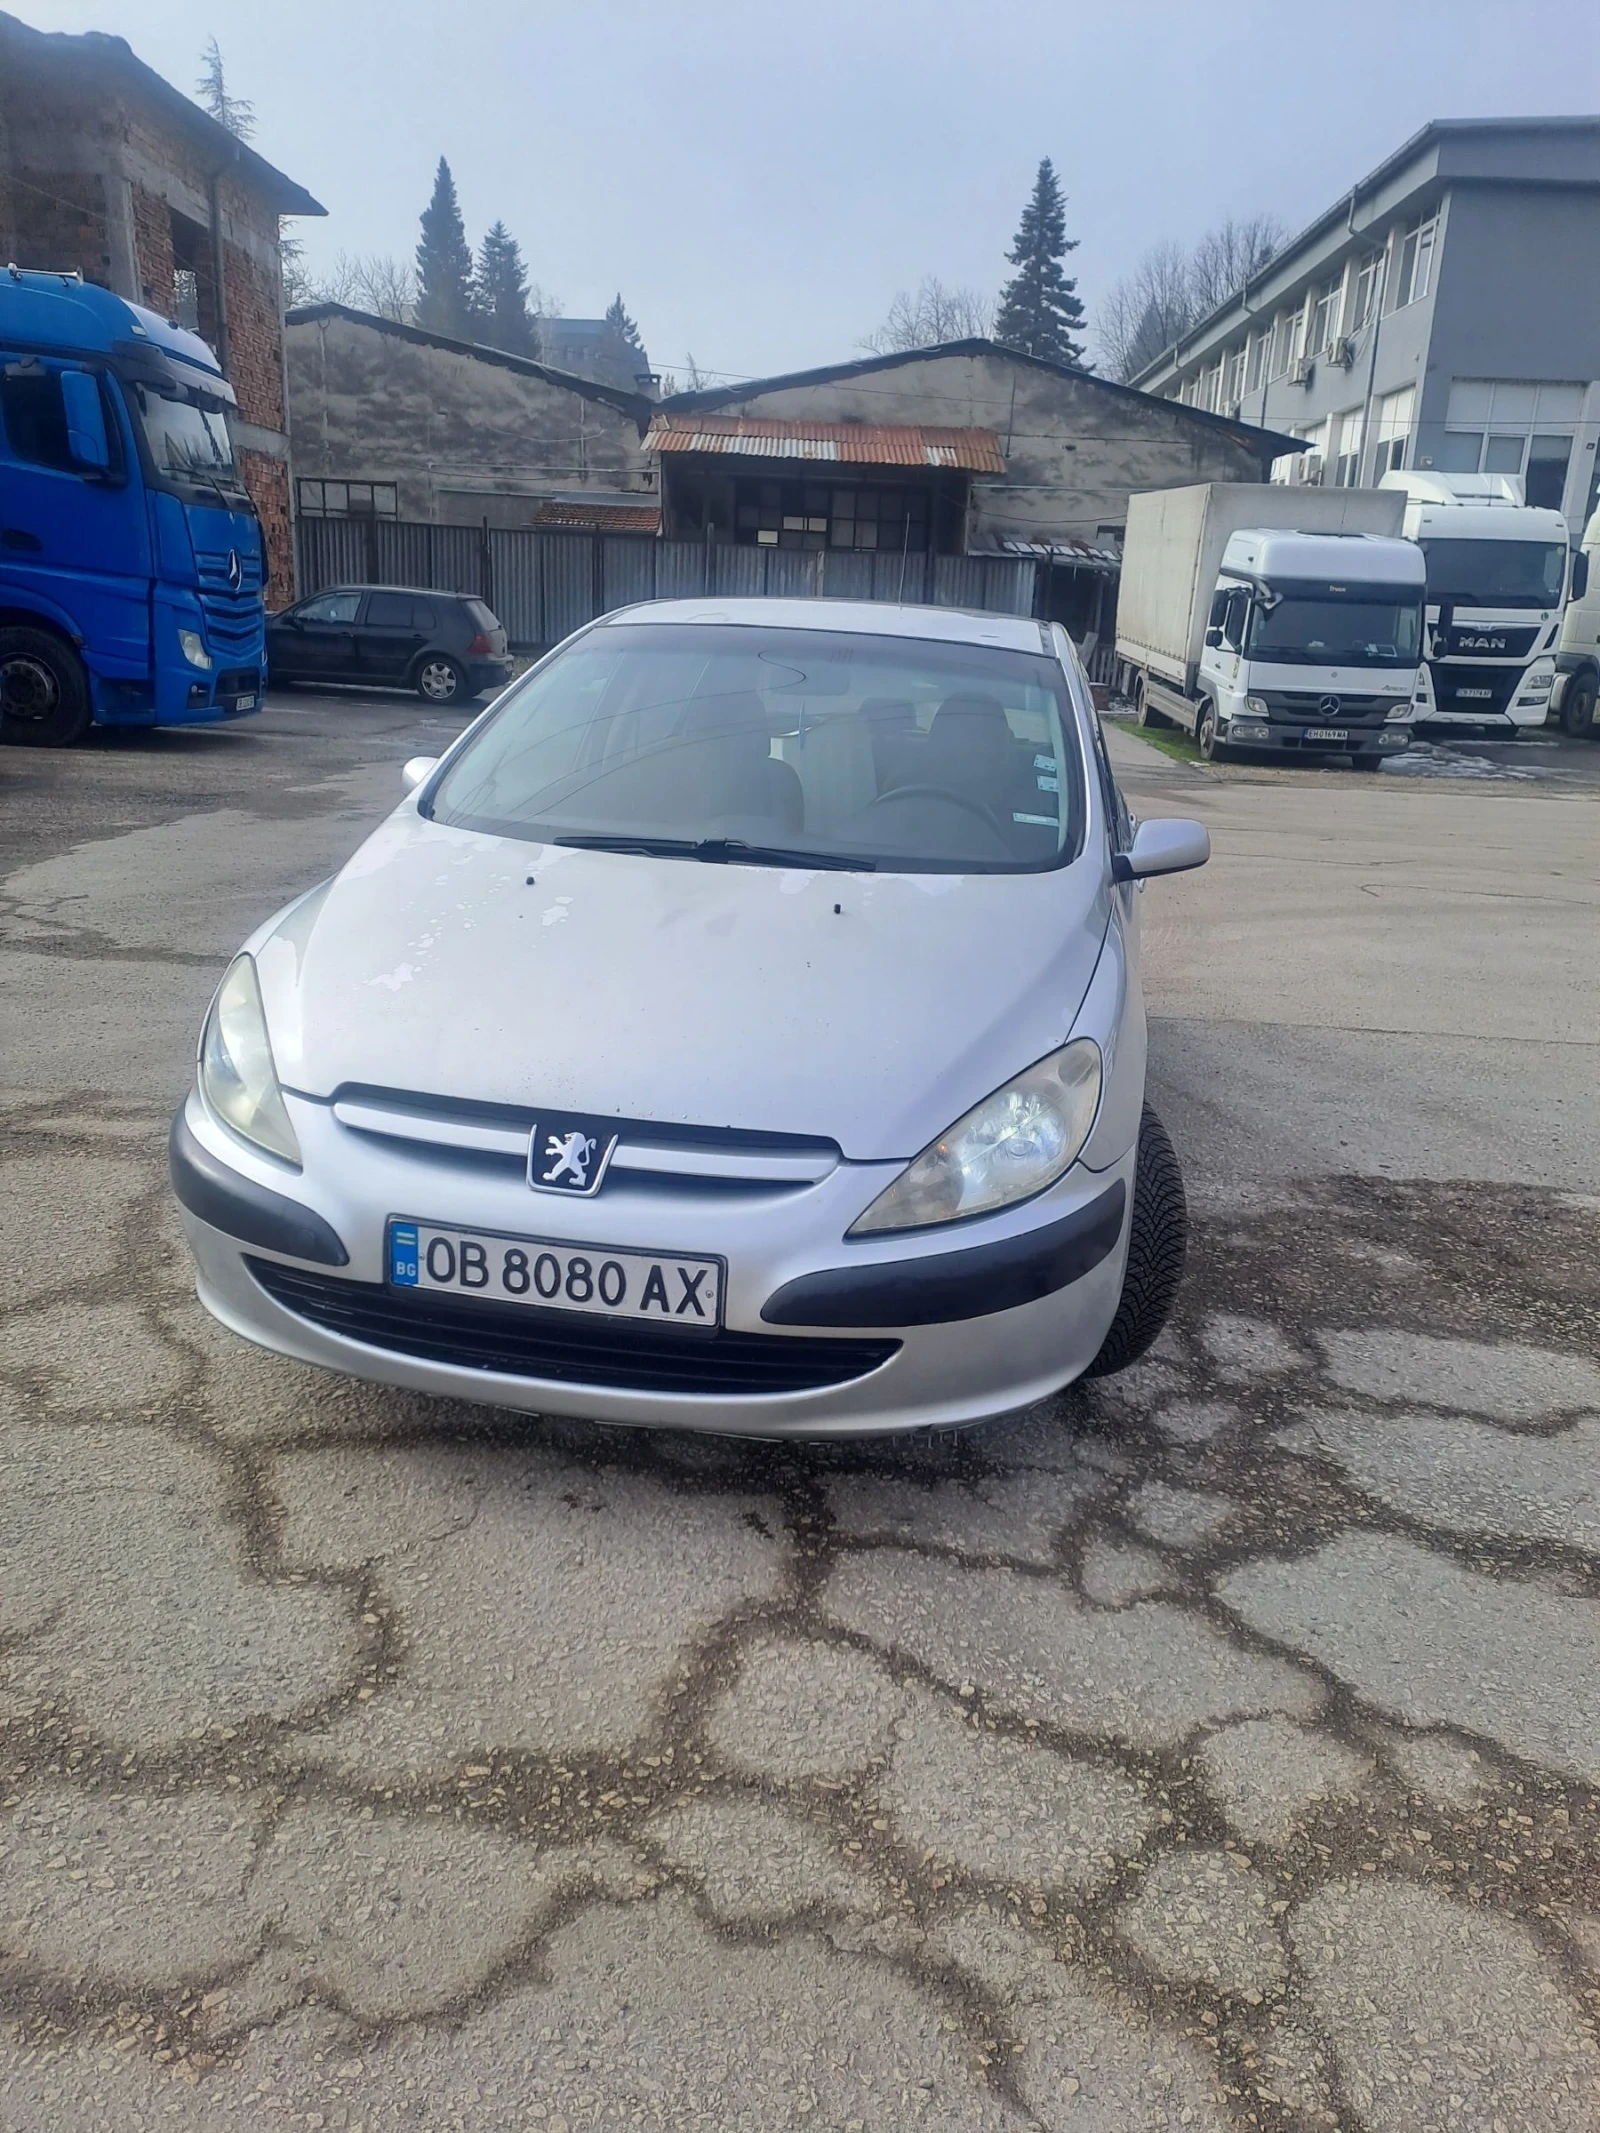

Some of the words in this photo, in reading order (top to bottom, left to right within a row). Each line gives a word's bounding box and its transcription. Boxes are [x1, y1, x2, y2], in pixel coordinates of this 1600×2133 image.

[1459, 636, 1507, 649] MAN
[396, 1260, 417, 1278] BG
[426, 1236, 490, 1288] OB
[502, 1248, 627, 1307] 8080
[639, 1264, 709, 1317] AX
